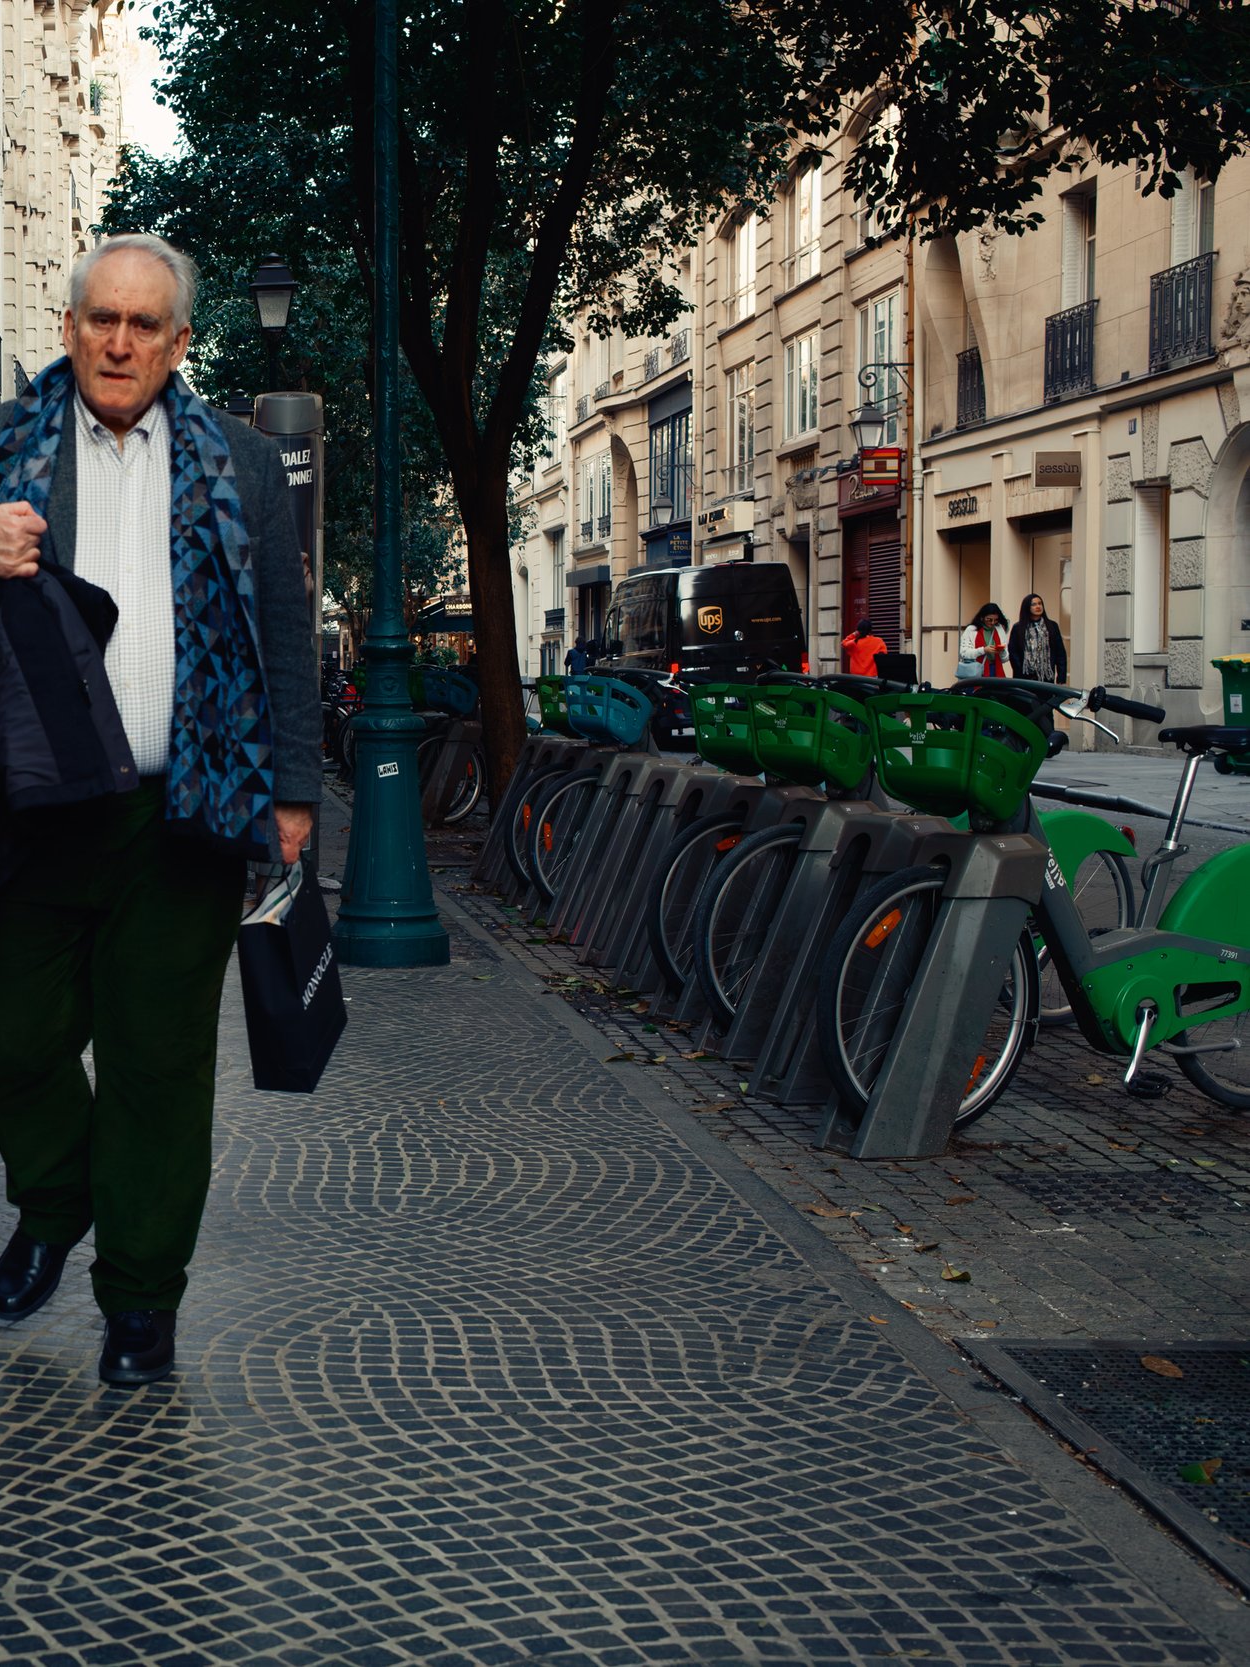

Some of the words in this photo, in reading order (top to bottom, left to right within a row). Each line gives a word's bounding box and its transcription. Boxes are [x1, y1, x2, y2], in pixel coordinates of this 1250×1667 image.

[279, 449, 311, 467] DALEZ
[1039, 462, 1079, 474] sessùn
[948, 491, 978, 519] sessùn
[700, 613, 721, 630] ups
[1220, 949, 1238, 960] 77391
